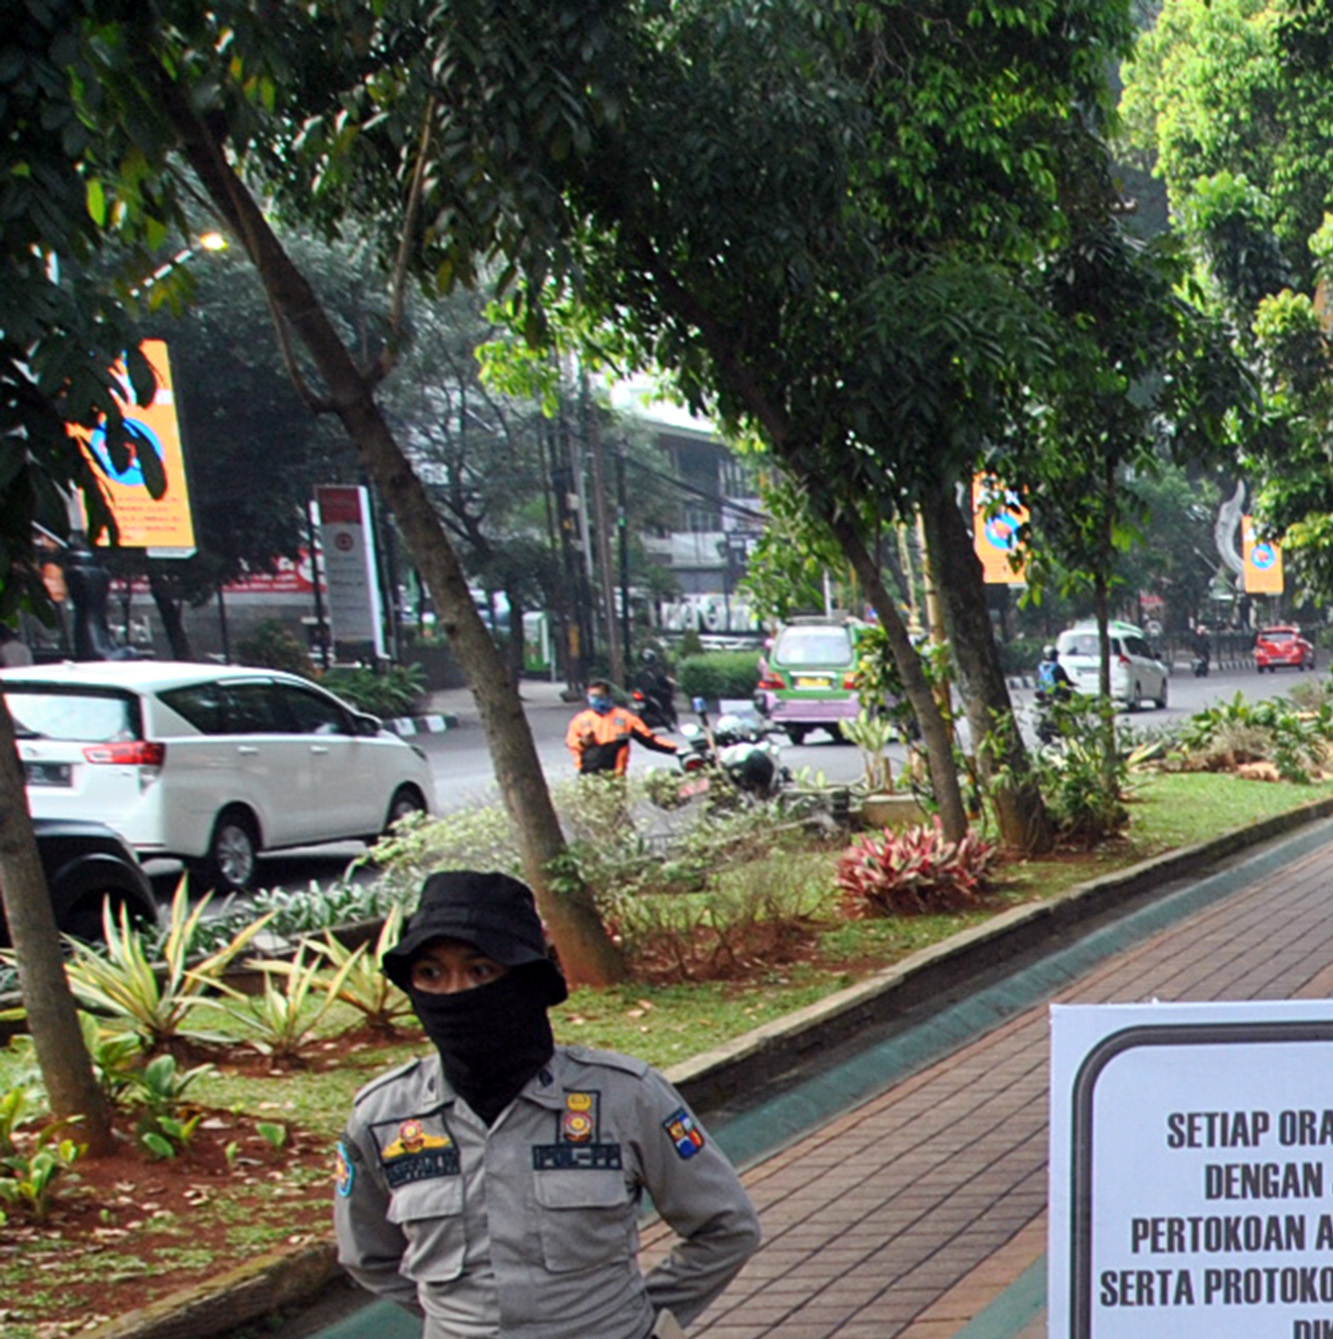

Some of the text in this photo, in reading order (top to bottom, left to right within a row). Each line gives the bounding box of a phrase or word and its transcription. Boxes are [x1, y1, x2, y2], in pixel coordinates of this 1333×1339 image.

[1167, 1111, 1269, 1149] SETIAP
[1205, 1162, 1323, 1200] DENGAN
[1132, 1214, 1305, 1254] PERTOKOAN
[1100, 1269, 1194, 1307] SERTA
